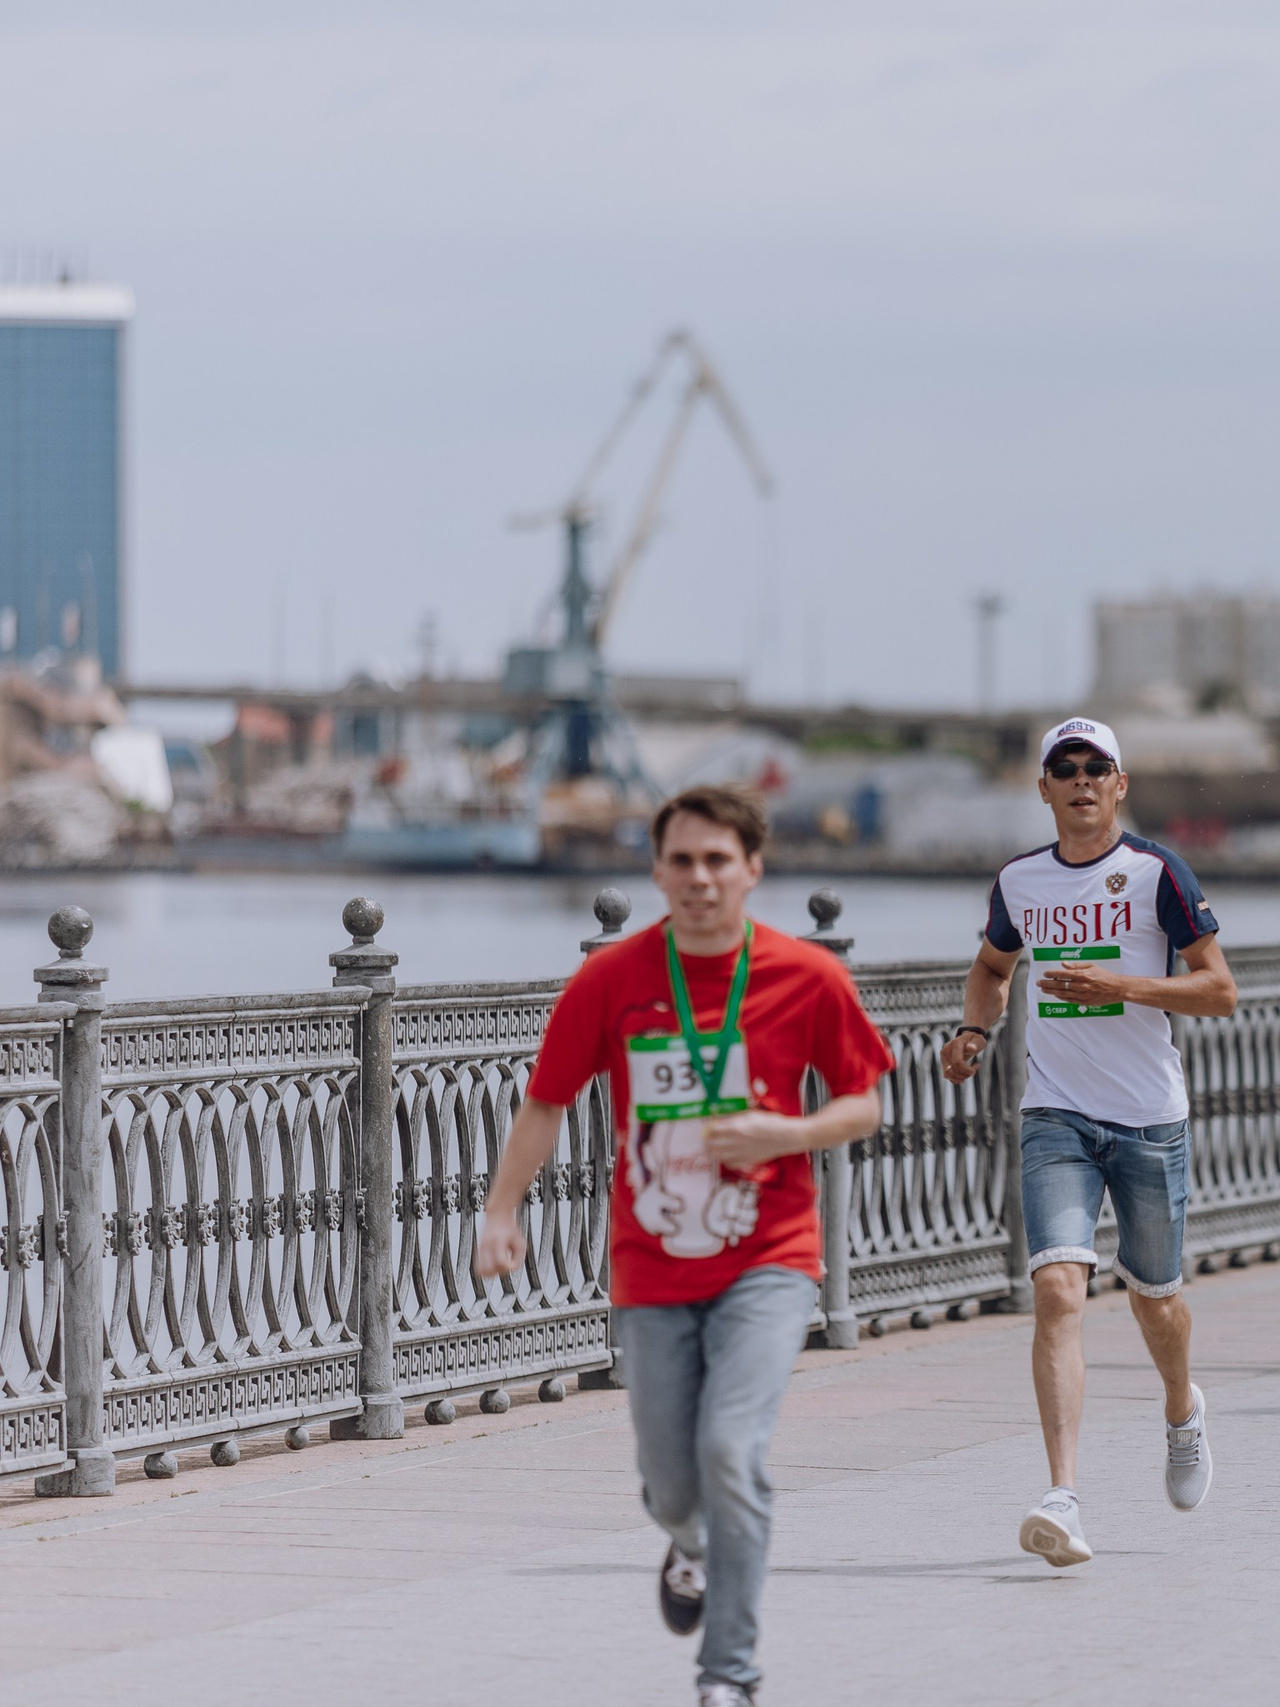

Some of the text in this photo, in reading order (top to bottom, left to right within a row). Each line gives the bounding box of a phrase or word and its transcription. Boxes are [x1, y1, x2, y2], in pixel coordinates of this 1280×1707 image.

[1057, 721, 1096, 737] RUSSIA
[1023, 901, 1132, 945] RUSSIA
[653, 1060, 716, 1094] 93
